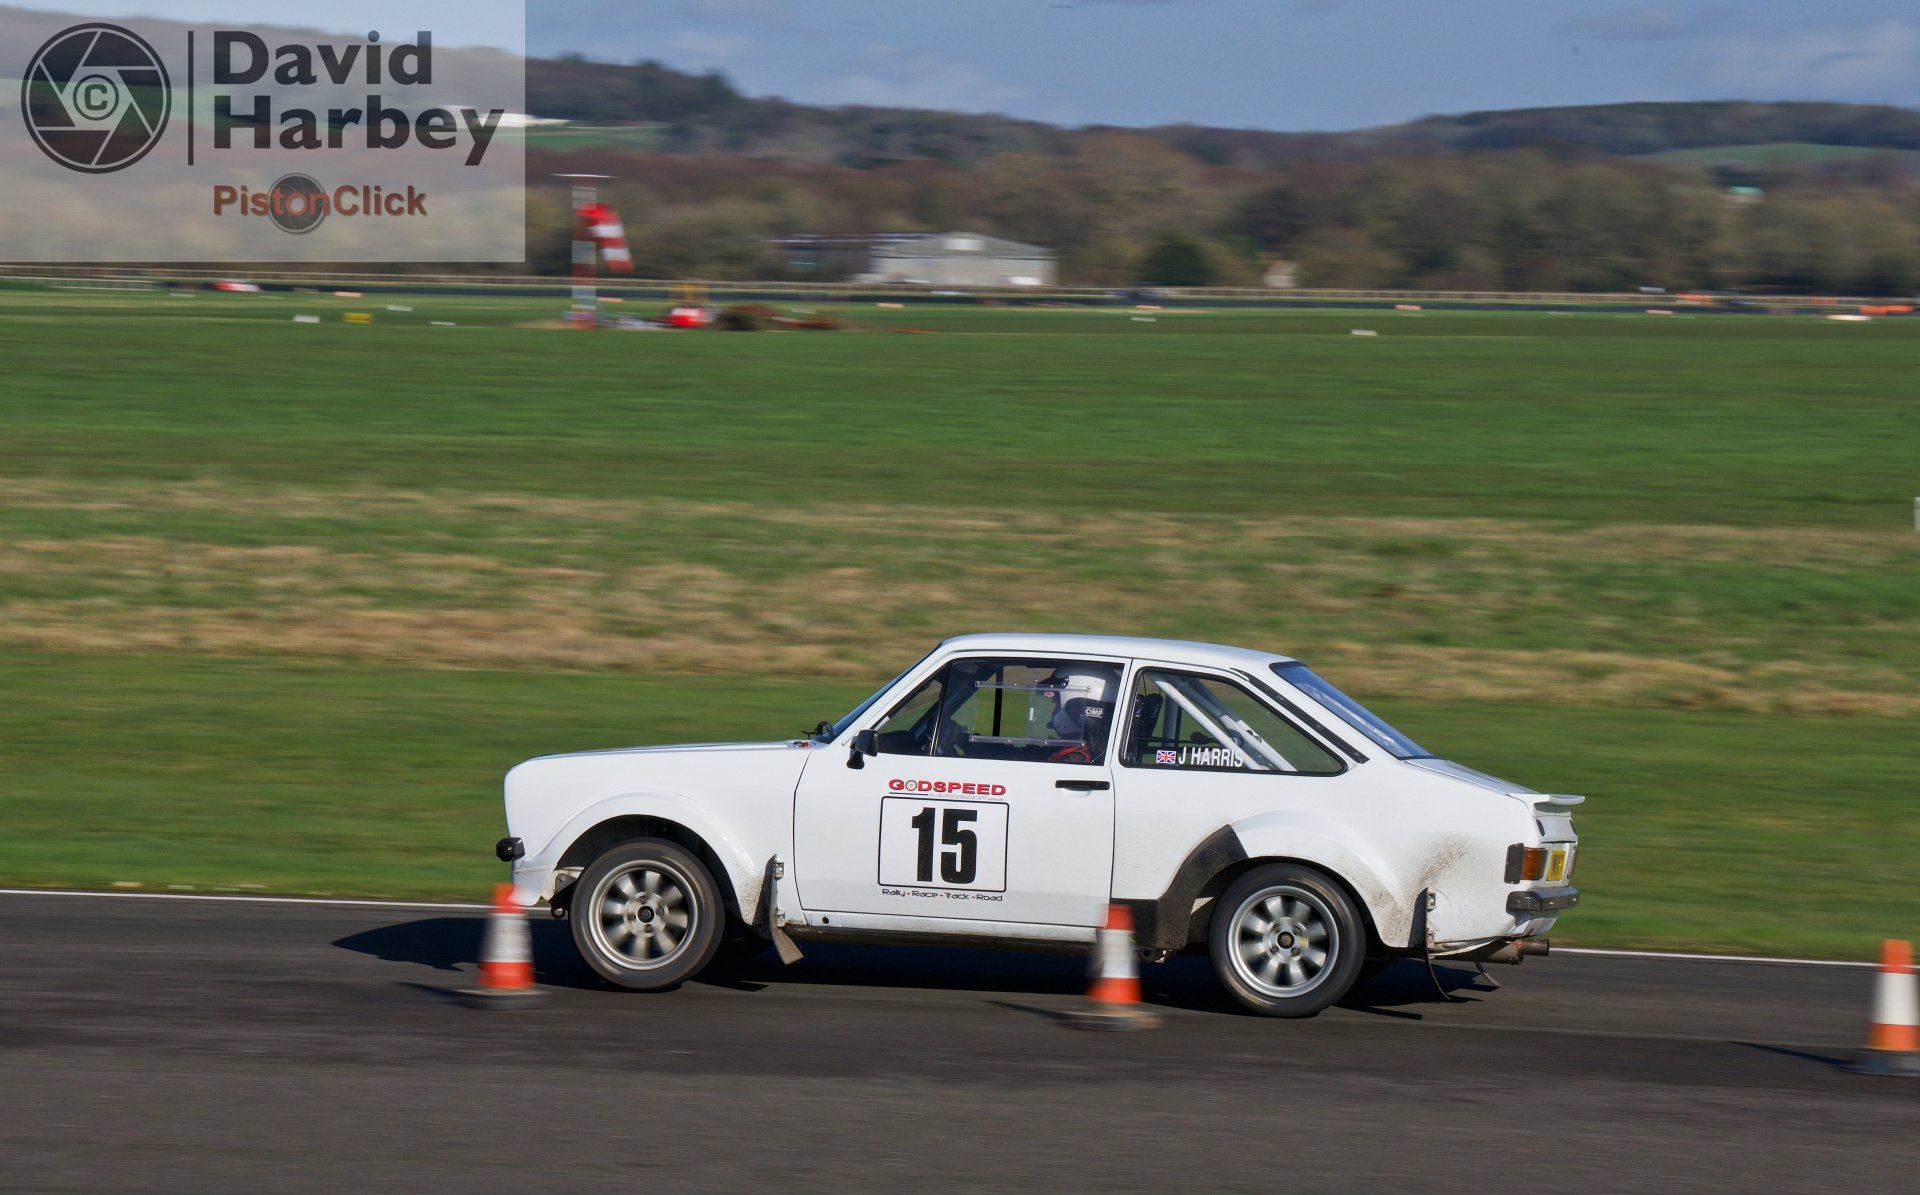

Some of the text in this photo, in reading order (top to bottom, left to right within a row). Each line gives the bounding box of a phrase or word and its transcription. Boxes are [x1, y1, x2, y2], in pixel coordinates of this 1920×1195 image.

[1085, 708, 1103, 717] OMP
[1178, 746, 1243, 767] J HARRIS
[888, 778, 1006, 795] GODSPEED
[911, 807, 978, 884] 15
[881, 888, 906, 897] Rally
[911, 890, 938, 898] Race
[976, 894, 1003, 902] Road
